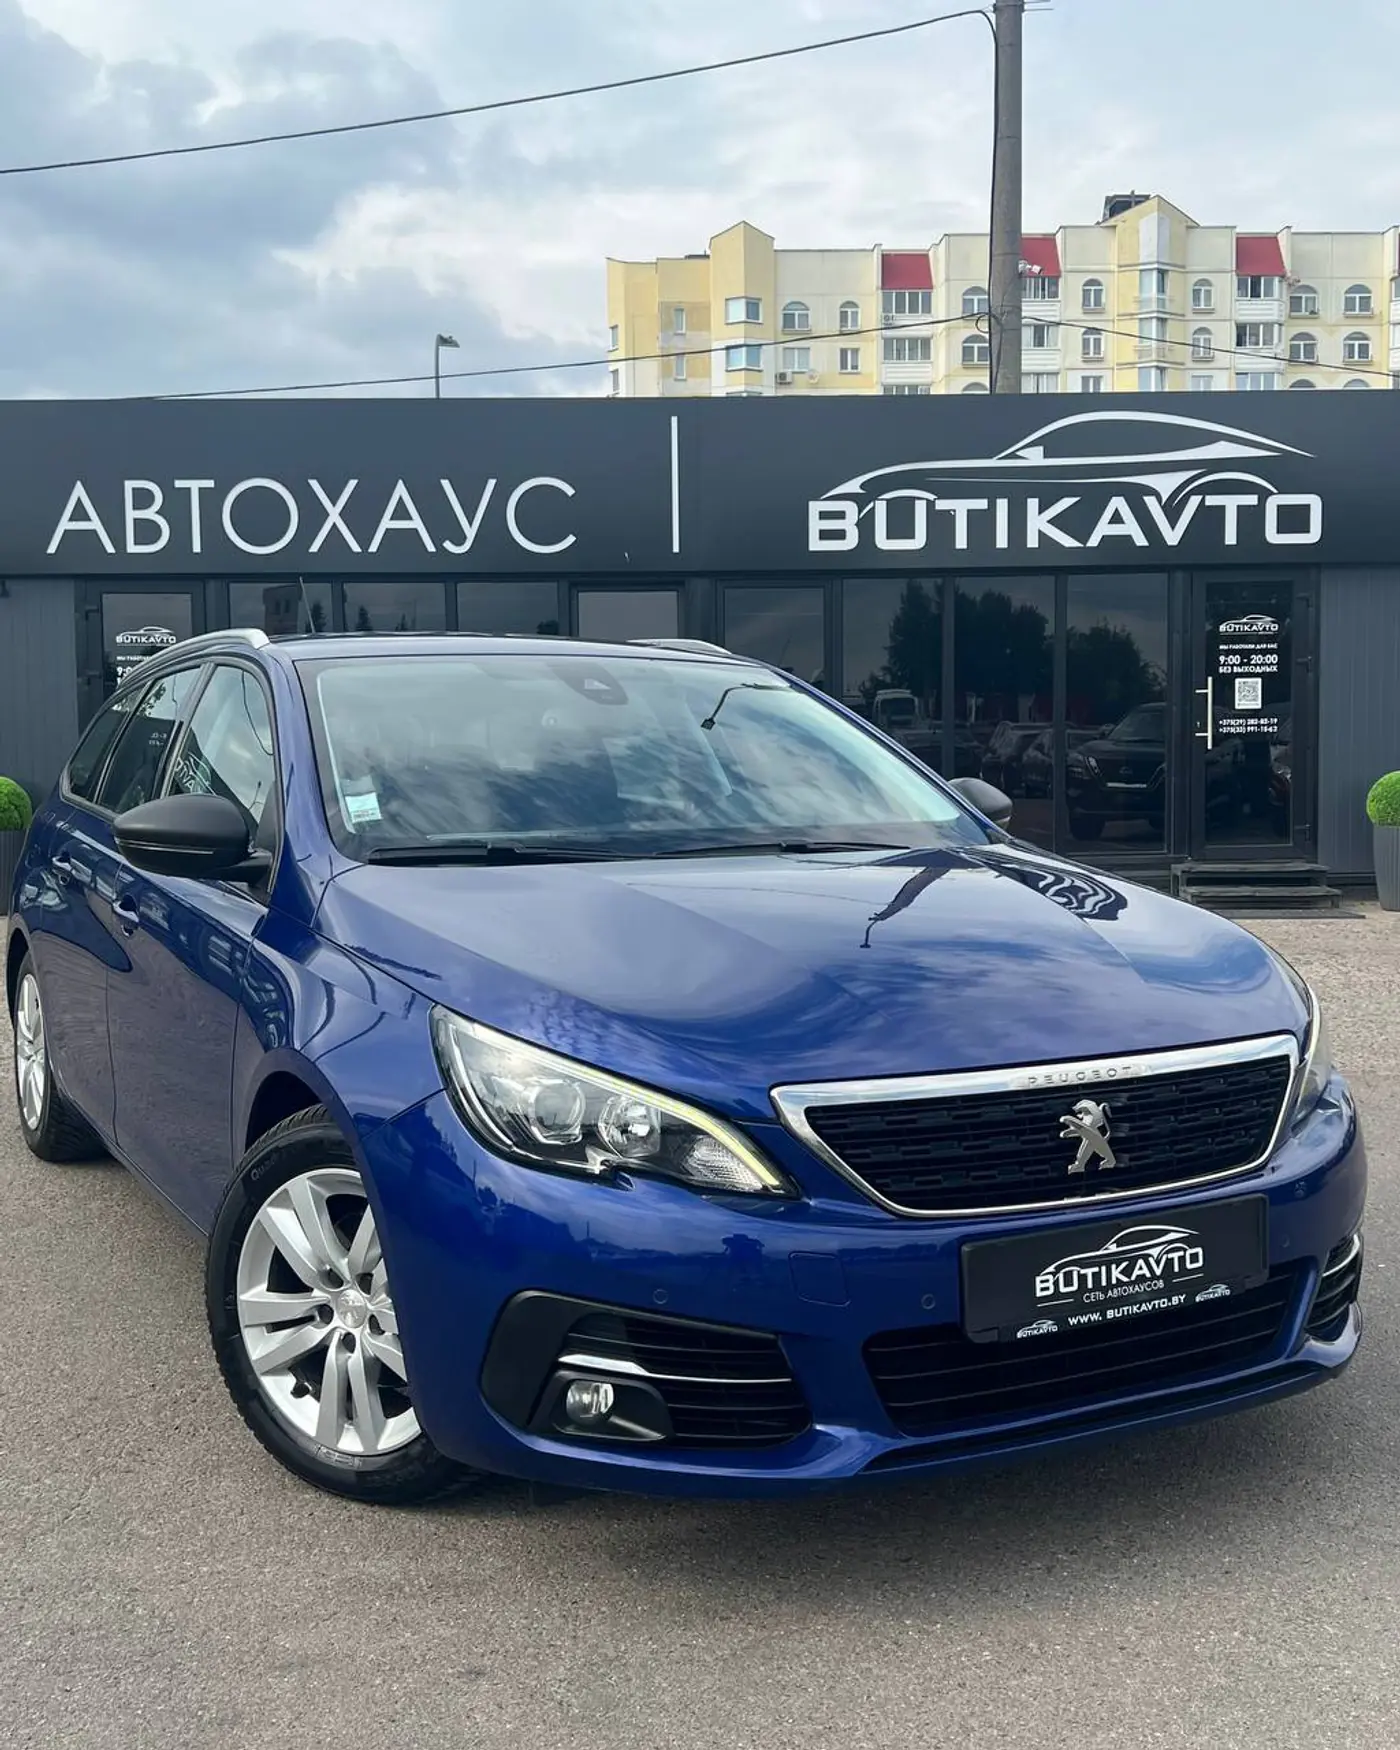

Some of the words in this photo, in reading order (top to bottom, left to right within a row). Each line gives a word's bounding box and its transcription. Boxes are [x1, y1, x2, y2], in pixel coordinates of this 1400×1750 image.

[46, 477, 577, 555] АВТОХАУС
[808, 493, 1323, 552] BUTIKAVTO
[1219, 623, 1279, 632] BUTIKAVTO
[116, 635, 176, 643] BUTIKAVTO
[1219, 654, 1241, 665] 9:00
[1250, 653, 1279, 664] 20:00
[1219, 665, 1232, 673] БЕЗ
[1233, 664, 1279, 673] ВЫХОДНЫХ
[1028, 1066, 1132, 1085] PEUGEOT
[1035, 1247, 1203, 1297] BUTIKAVTO
[1082, 1291, 1105, 1303] СЕТЬ
[1106, 1279, 1165, 1299] АВТОХАУСОВ
[1067, 1312, 1102, 1326] WWW.
[1106, 1294, 1186, 1319] BUTIKAVTO.BY
